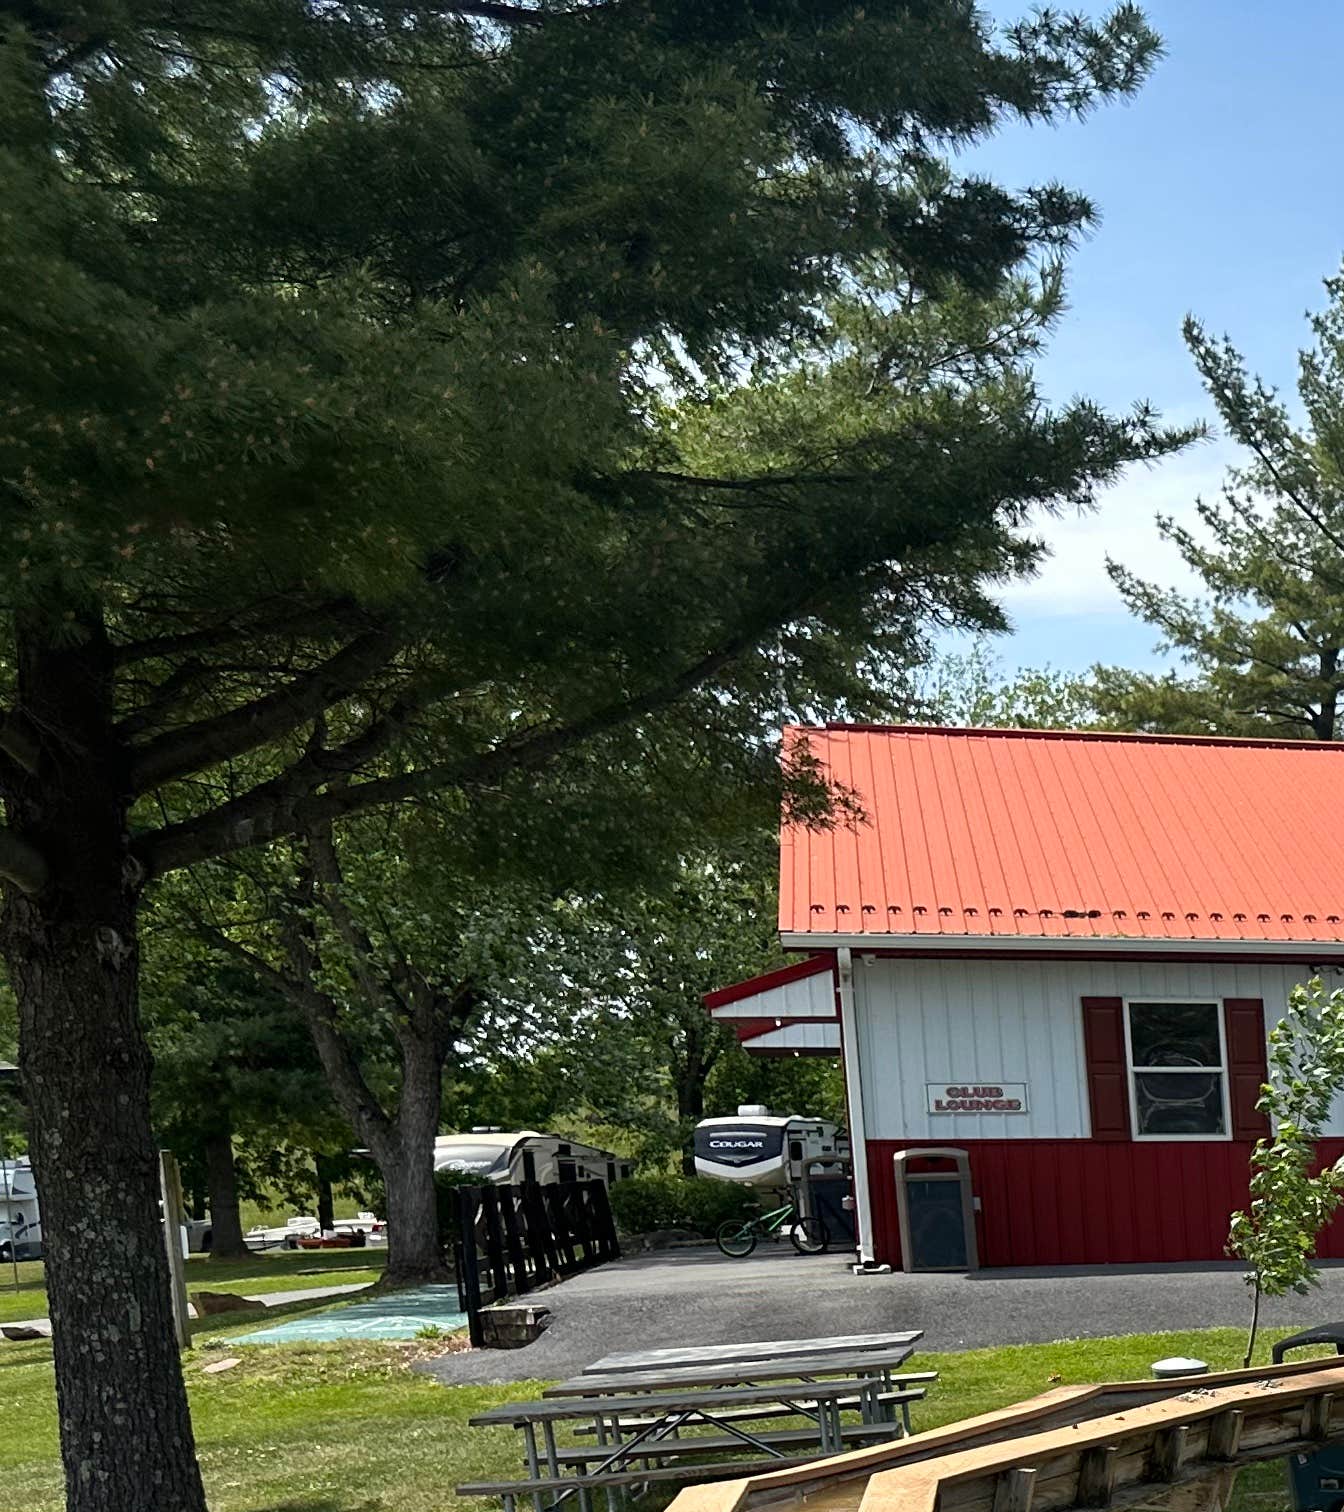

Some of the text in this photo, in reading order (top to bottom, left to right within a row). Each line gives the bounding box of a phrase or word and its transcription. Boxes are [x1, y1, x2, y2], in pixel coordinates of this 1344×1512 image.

[946, 1087, 1004, 1099] CLUB
[935, 1099, 1022, 1111] LOUNGE
[709, 1140, 763, 1149] COUGAR
